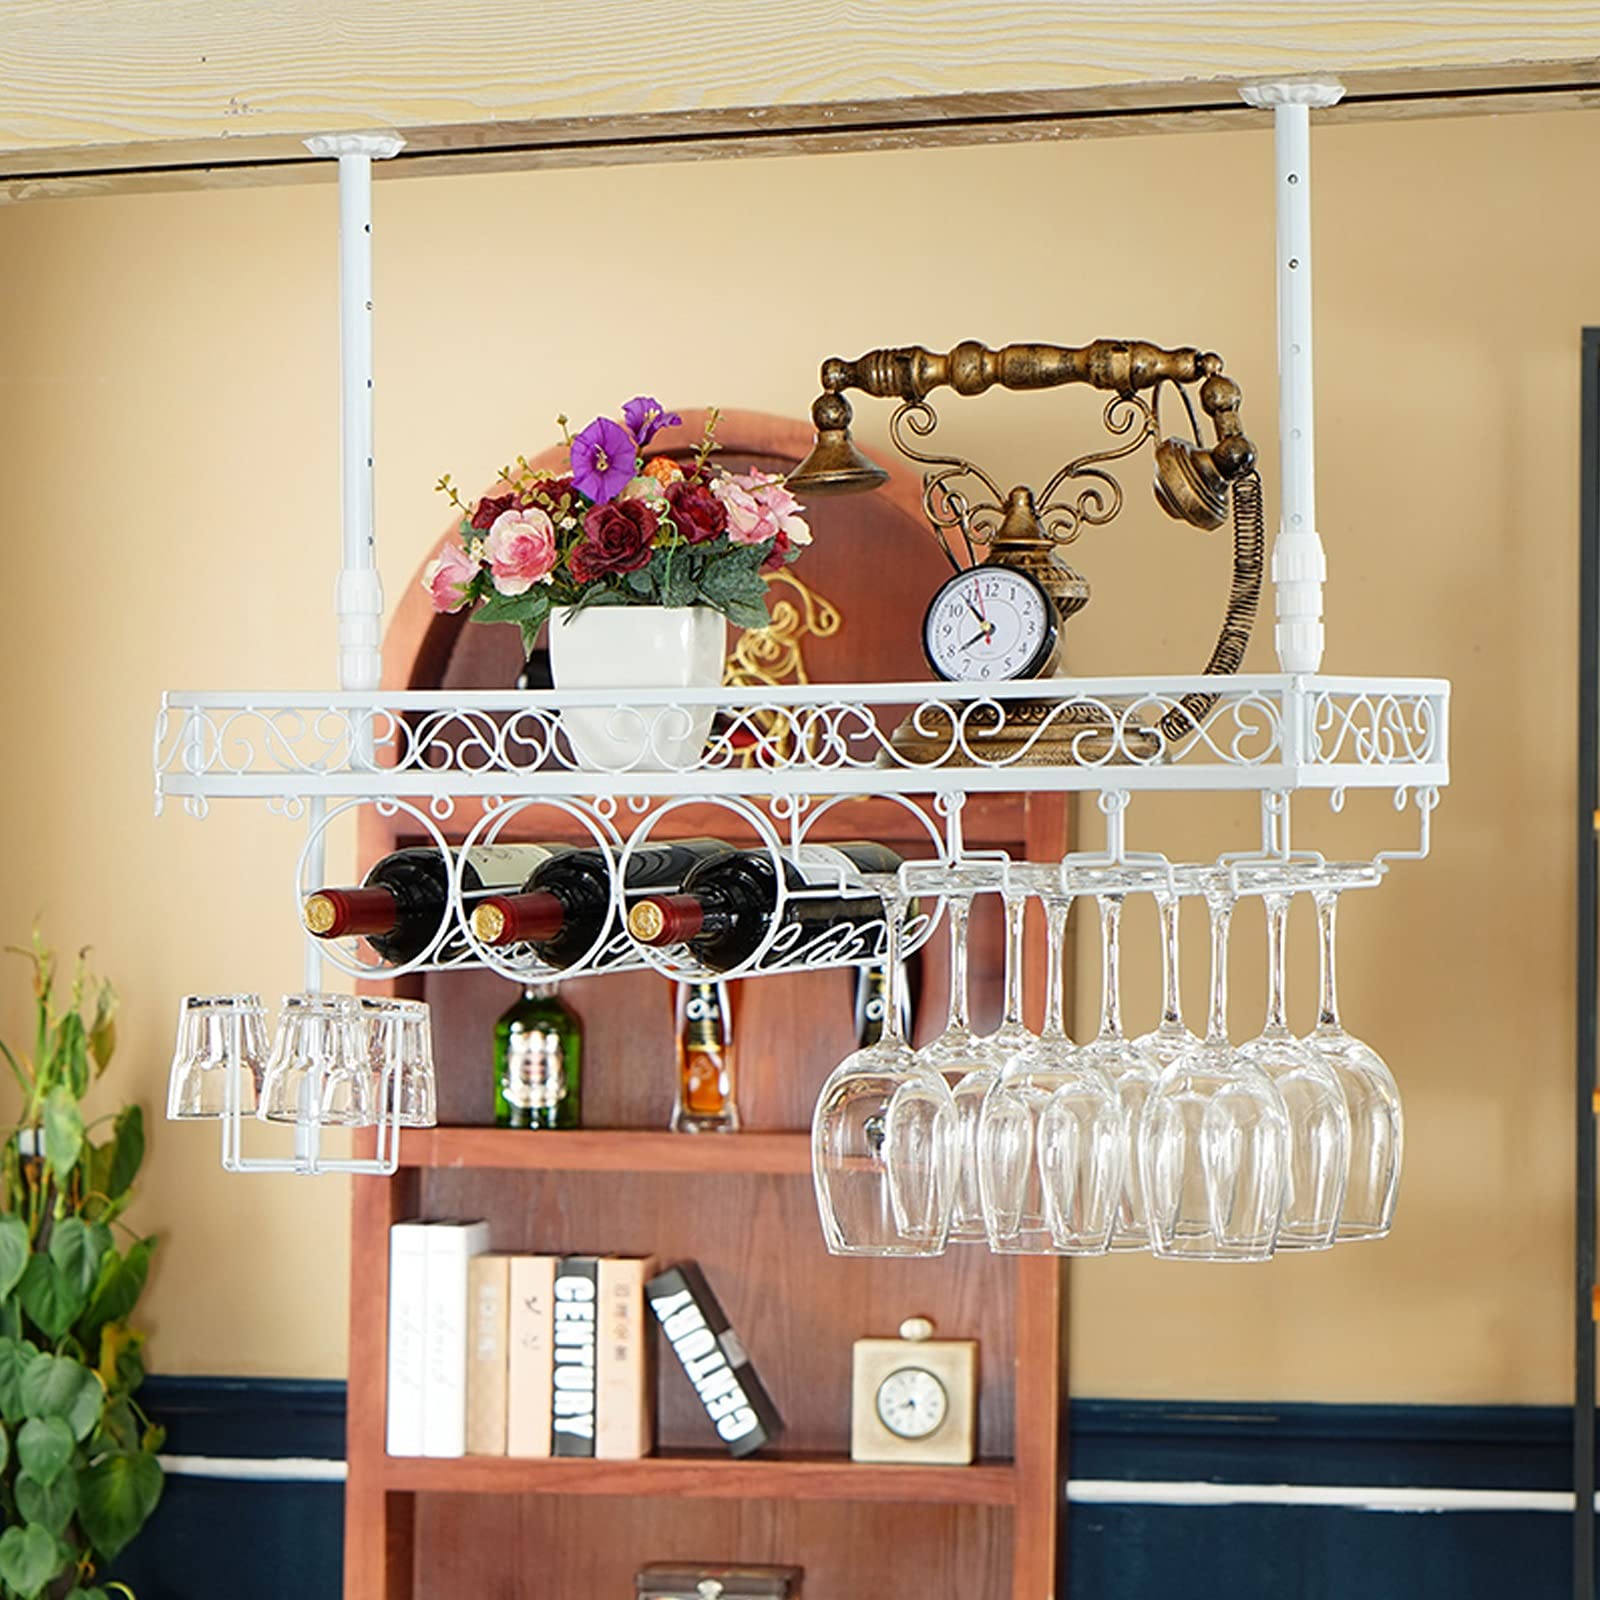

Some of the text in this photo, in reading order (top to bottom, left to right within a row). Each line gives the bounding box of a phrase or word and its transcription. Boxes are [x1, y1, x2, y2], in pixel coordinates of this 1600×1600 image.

[966, 588, 979, 602] 11
[985, 582, 1000, 598] 12
[1010, 587, 1016, 601] 1
[948, 604, 964, 618] 10
[1023, 600, 1032, 616] 2
[942, 624, 952, 638] 9
[1027, 621, 1036, 636] 3
[946, 644, 956, 658] 8
[1019, 642, 1028, 655] 4
[961, 659, 971, 673] 7
[980, 664, 990, 679] 6
[1003, 657, 1013, 672] 5
[554, 1276, 595, 1439] CENTURY
[651, 1290, 758, 1442] CENTURY
